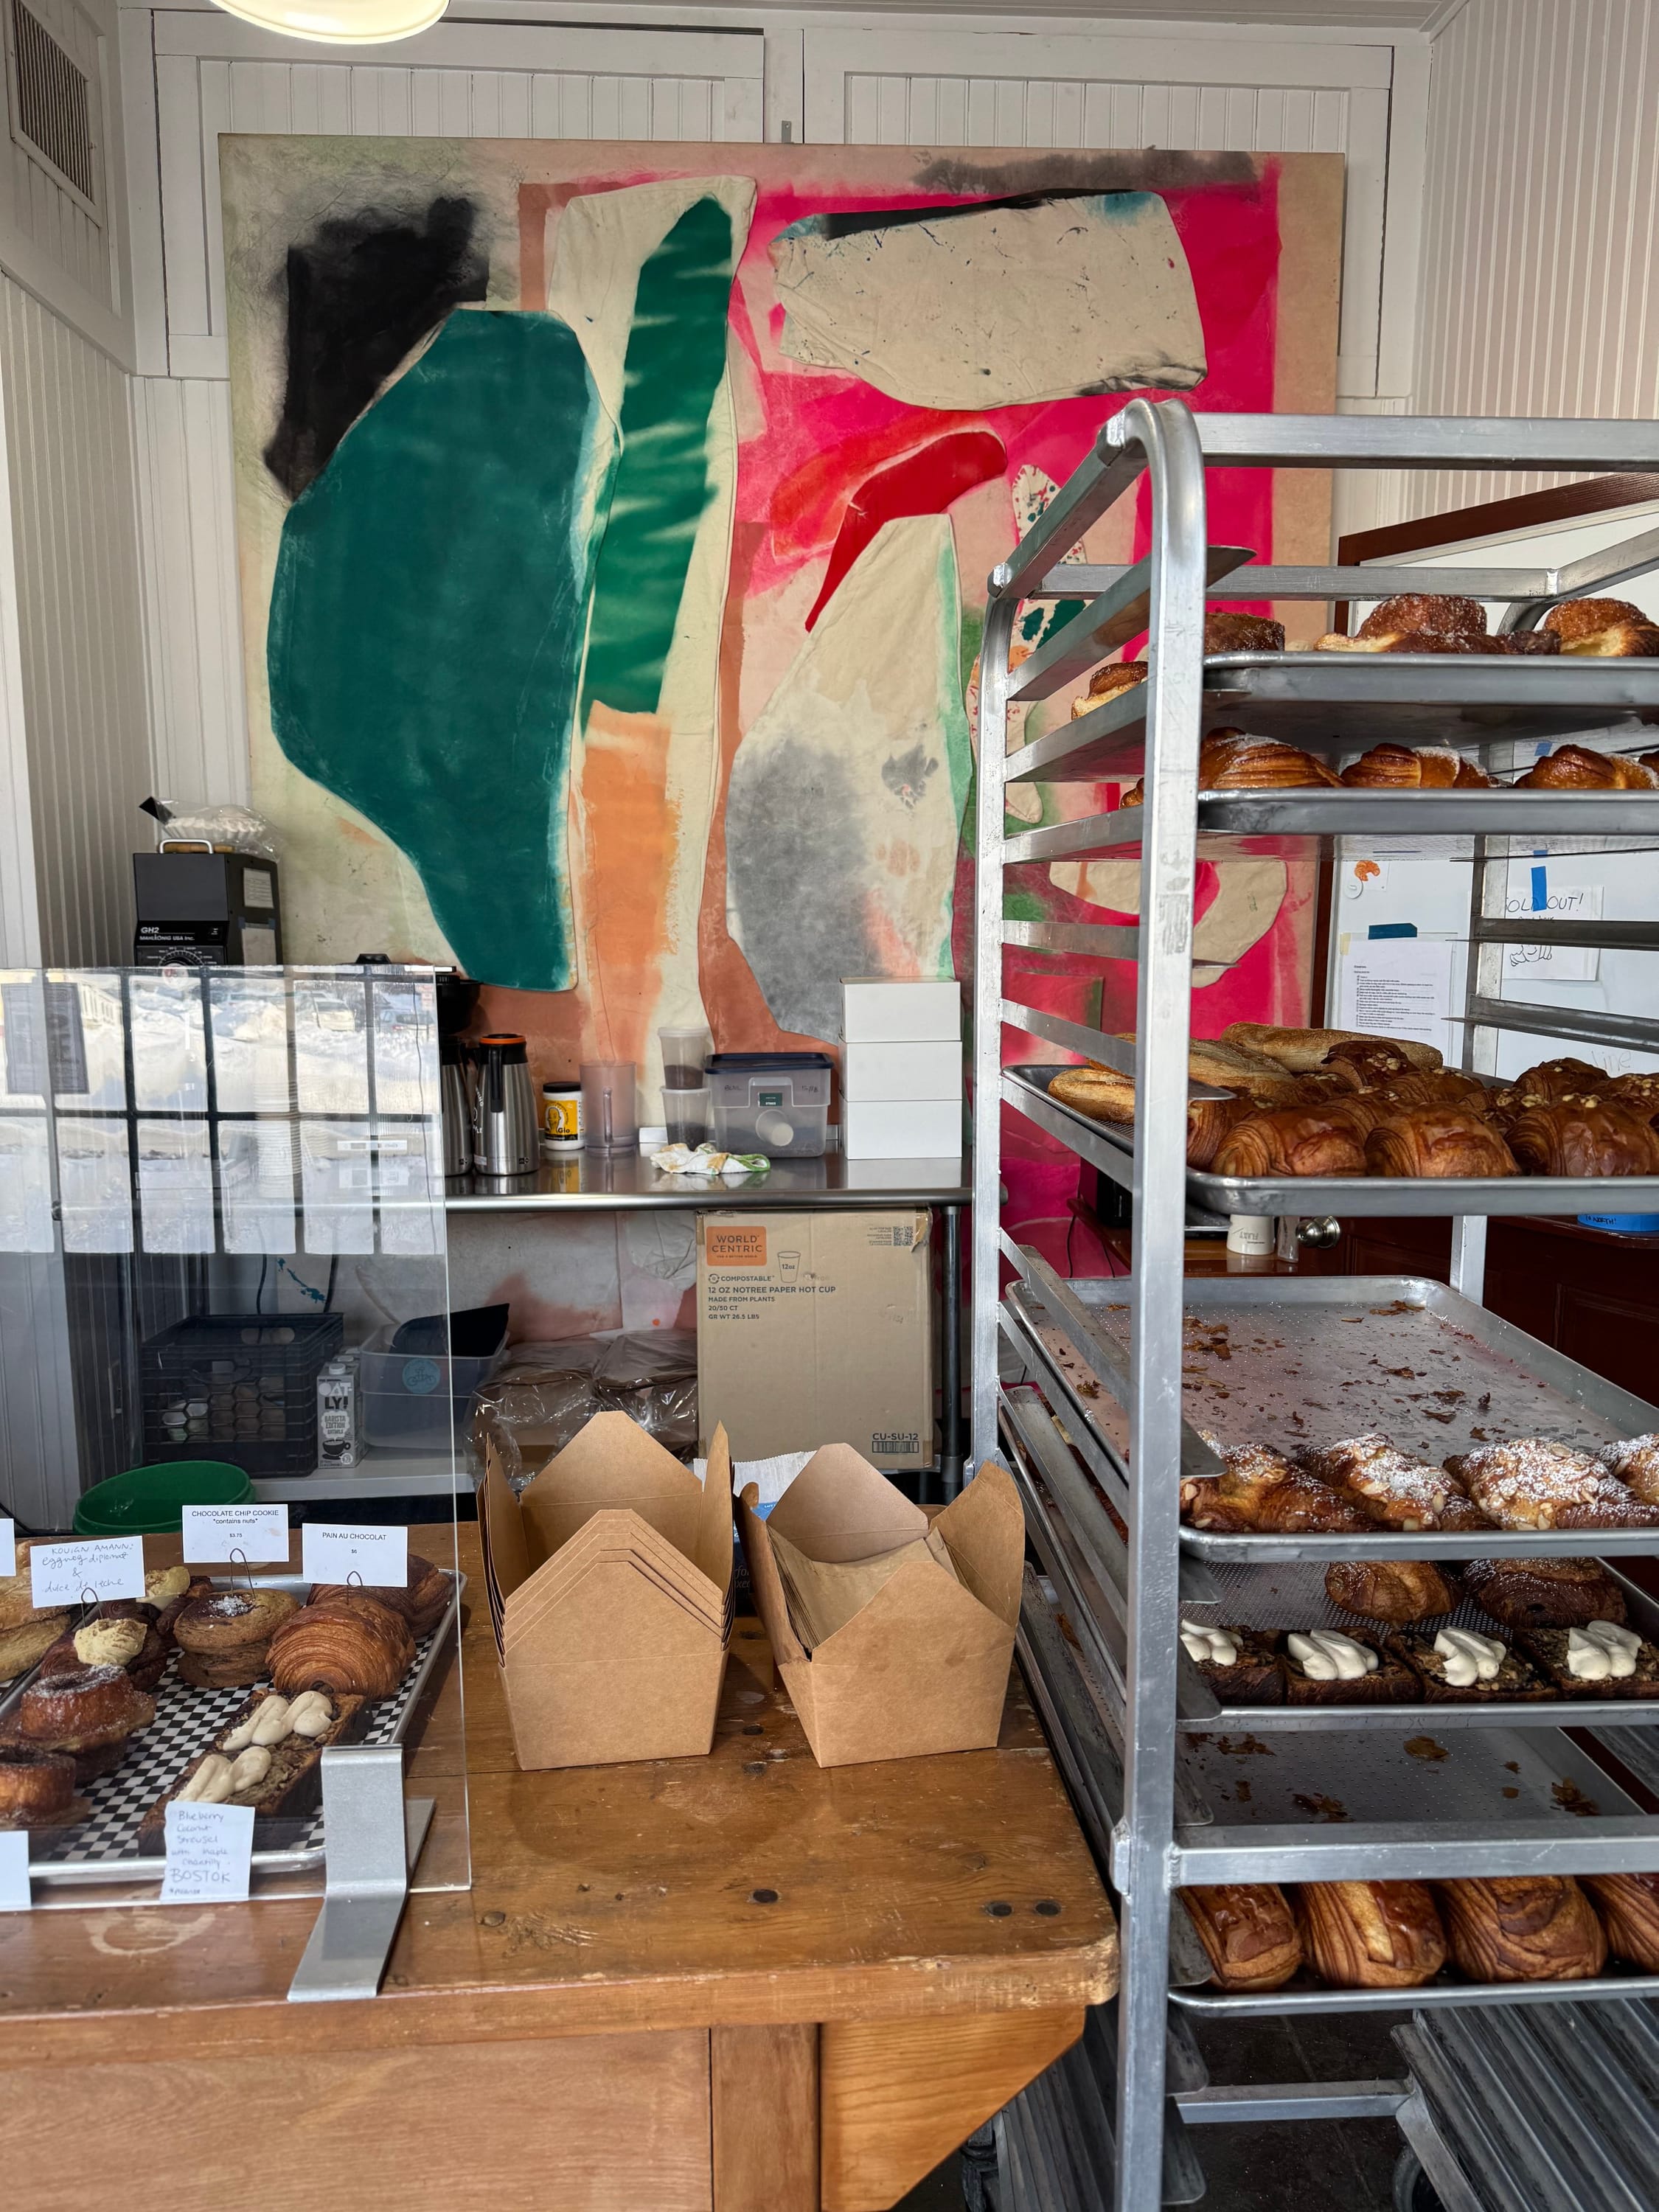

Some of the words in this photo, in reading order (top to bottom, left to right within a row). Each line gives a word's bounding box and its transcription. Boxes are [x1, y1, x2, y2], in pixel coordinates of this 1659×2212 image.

[1506, 897, 1540, 913] OLD
[1546, 892, 1584, 911] OUT!
[717, 1235, 757, 1243] WORLD
[712, 1245, 763, 1253] CENTRIC
[708, 1286, 717, 1294] 12
[718, 1286, 731, 1294] OZ
[733, 1286, 768, 1294] NOTREE
[769, 1286, 796, 1294] PAPER
[799, 1286, 816, 1294] HOT
[818, 1286, 836, 1294] CUP
[324, 1397, 349, 1409] LY!
[52, 1546, 89, 1555] KOUIGN
[42, 1554, 88, 1569] eggnog
[72, 1567, 83, 1579] &
[45, 1581, 70, 1593] dulce
[75, 1580, 88, 1592] de
[170, 1868, 231, 1884] BOSTOK
